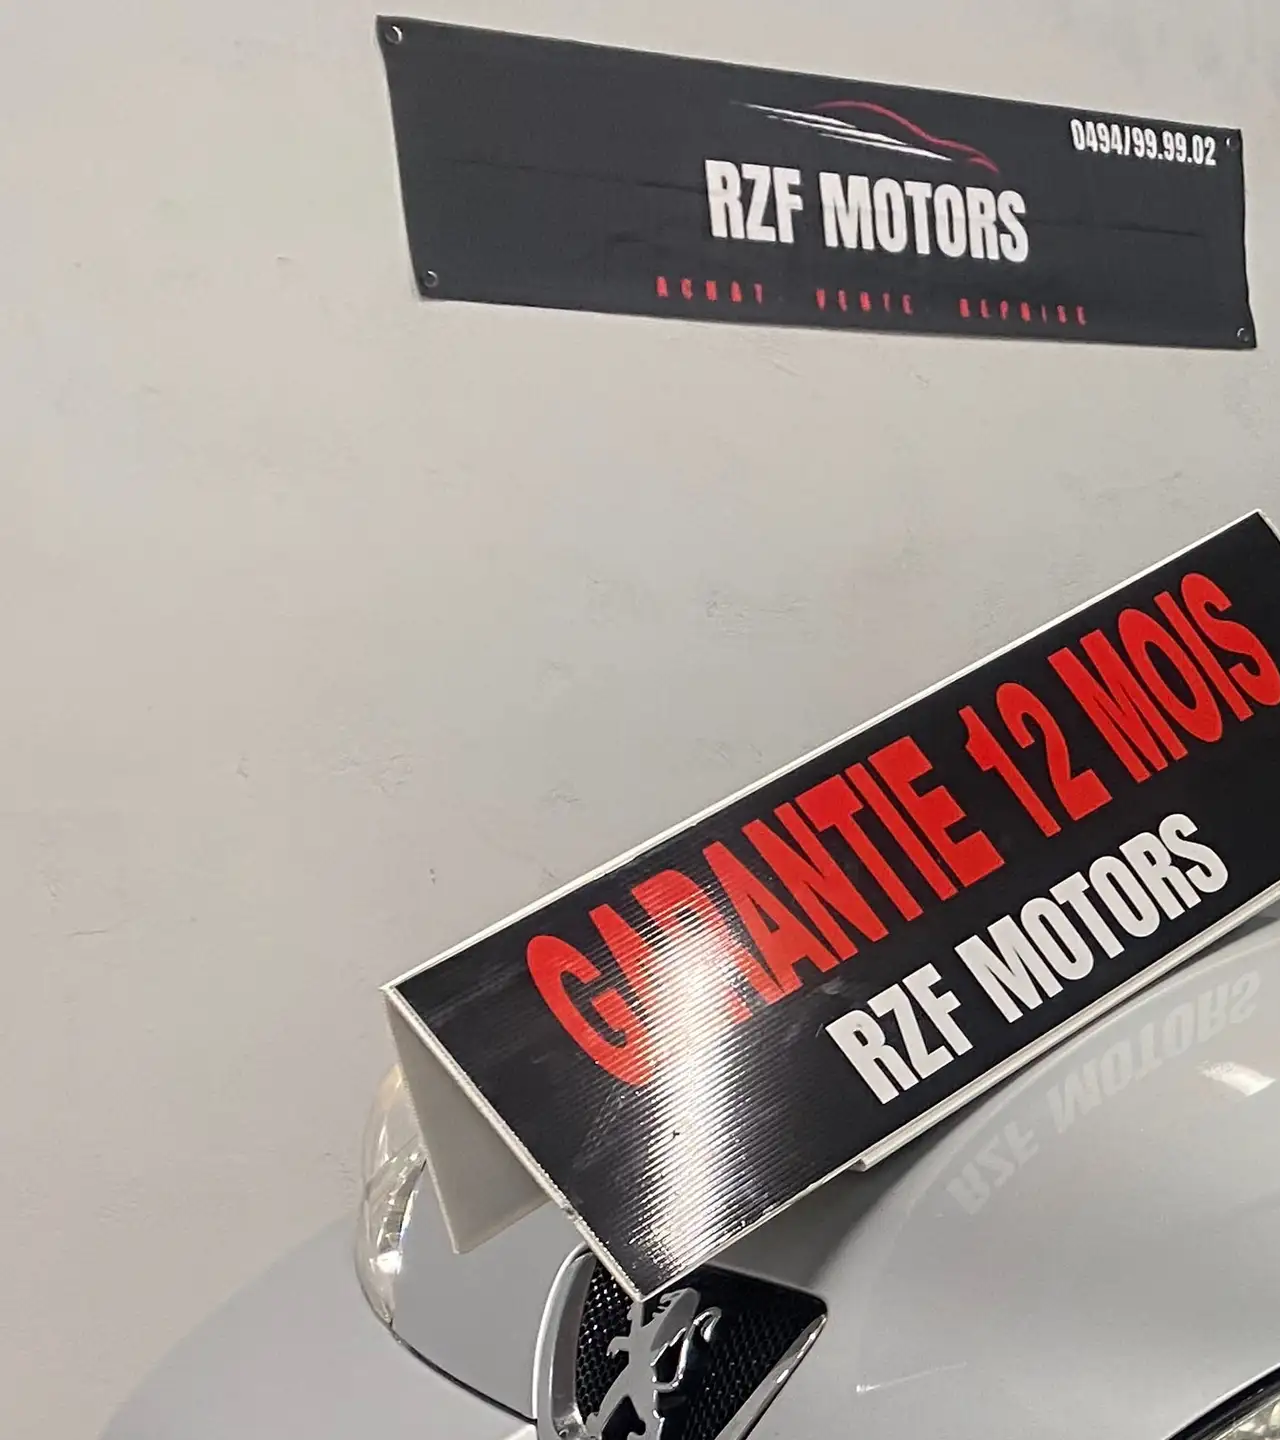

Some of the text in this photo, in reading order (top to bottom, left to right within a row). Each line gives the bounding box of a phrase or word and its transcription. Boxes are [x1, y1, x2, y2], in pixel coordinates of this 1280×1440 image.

[706, 160, 1029, 263] RZF MOTORS
[1070, 118, 1217, 166] 0494/99.99.02
[526, 736, 1004, 1086] GARANTIE
[959, 681, 1113, 838] 12
[825, 813, 1230, 1105] RZF MOTORS
